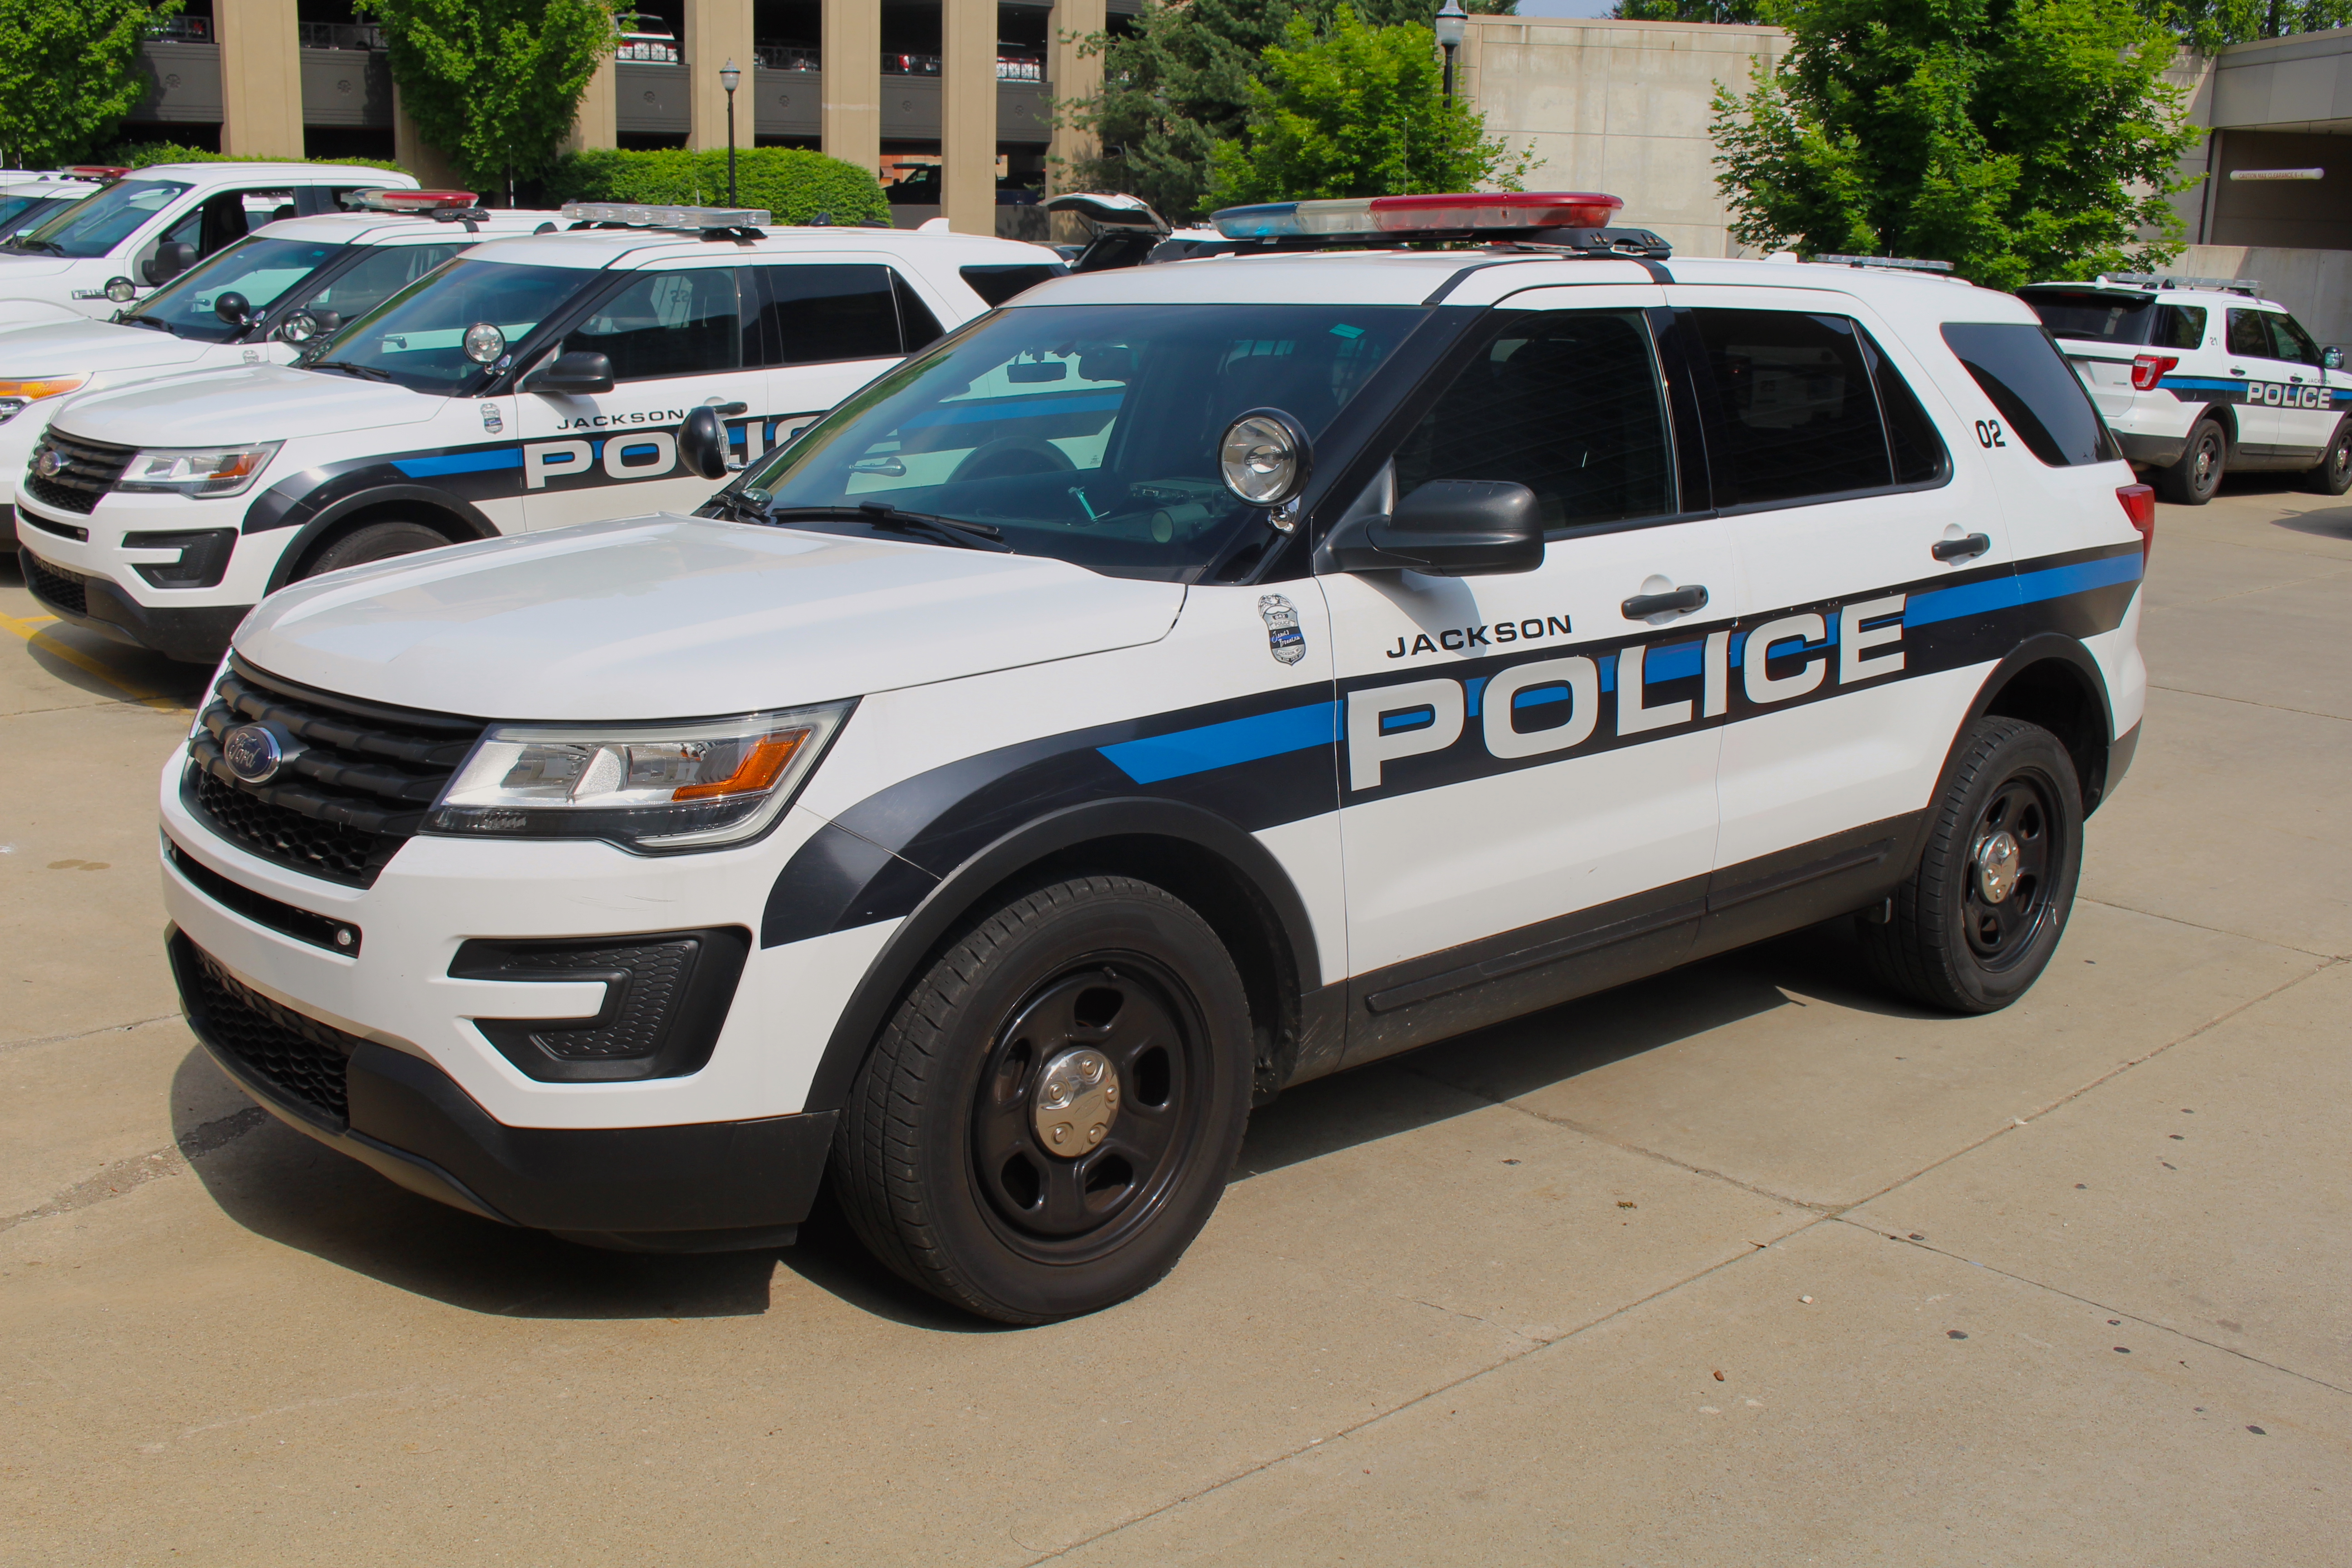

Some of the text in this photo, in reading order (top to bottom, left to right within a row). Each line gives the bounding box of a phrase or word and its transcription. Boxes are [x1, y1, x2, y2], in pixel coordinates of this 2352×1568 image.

[670, 289, 690, 303] 22
[2209, 337, 2218, 346] 21
[2246, 381, 2332, 409] POLICE
[556, 409, 684, 430] JACKSON
[1975, 419, 2006, 449] 02
[1386, 614, 1573, 659] JACKSON
[1348, 593, 1907, 792] POLICE
[228, 732, 262, 769] Ford
